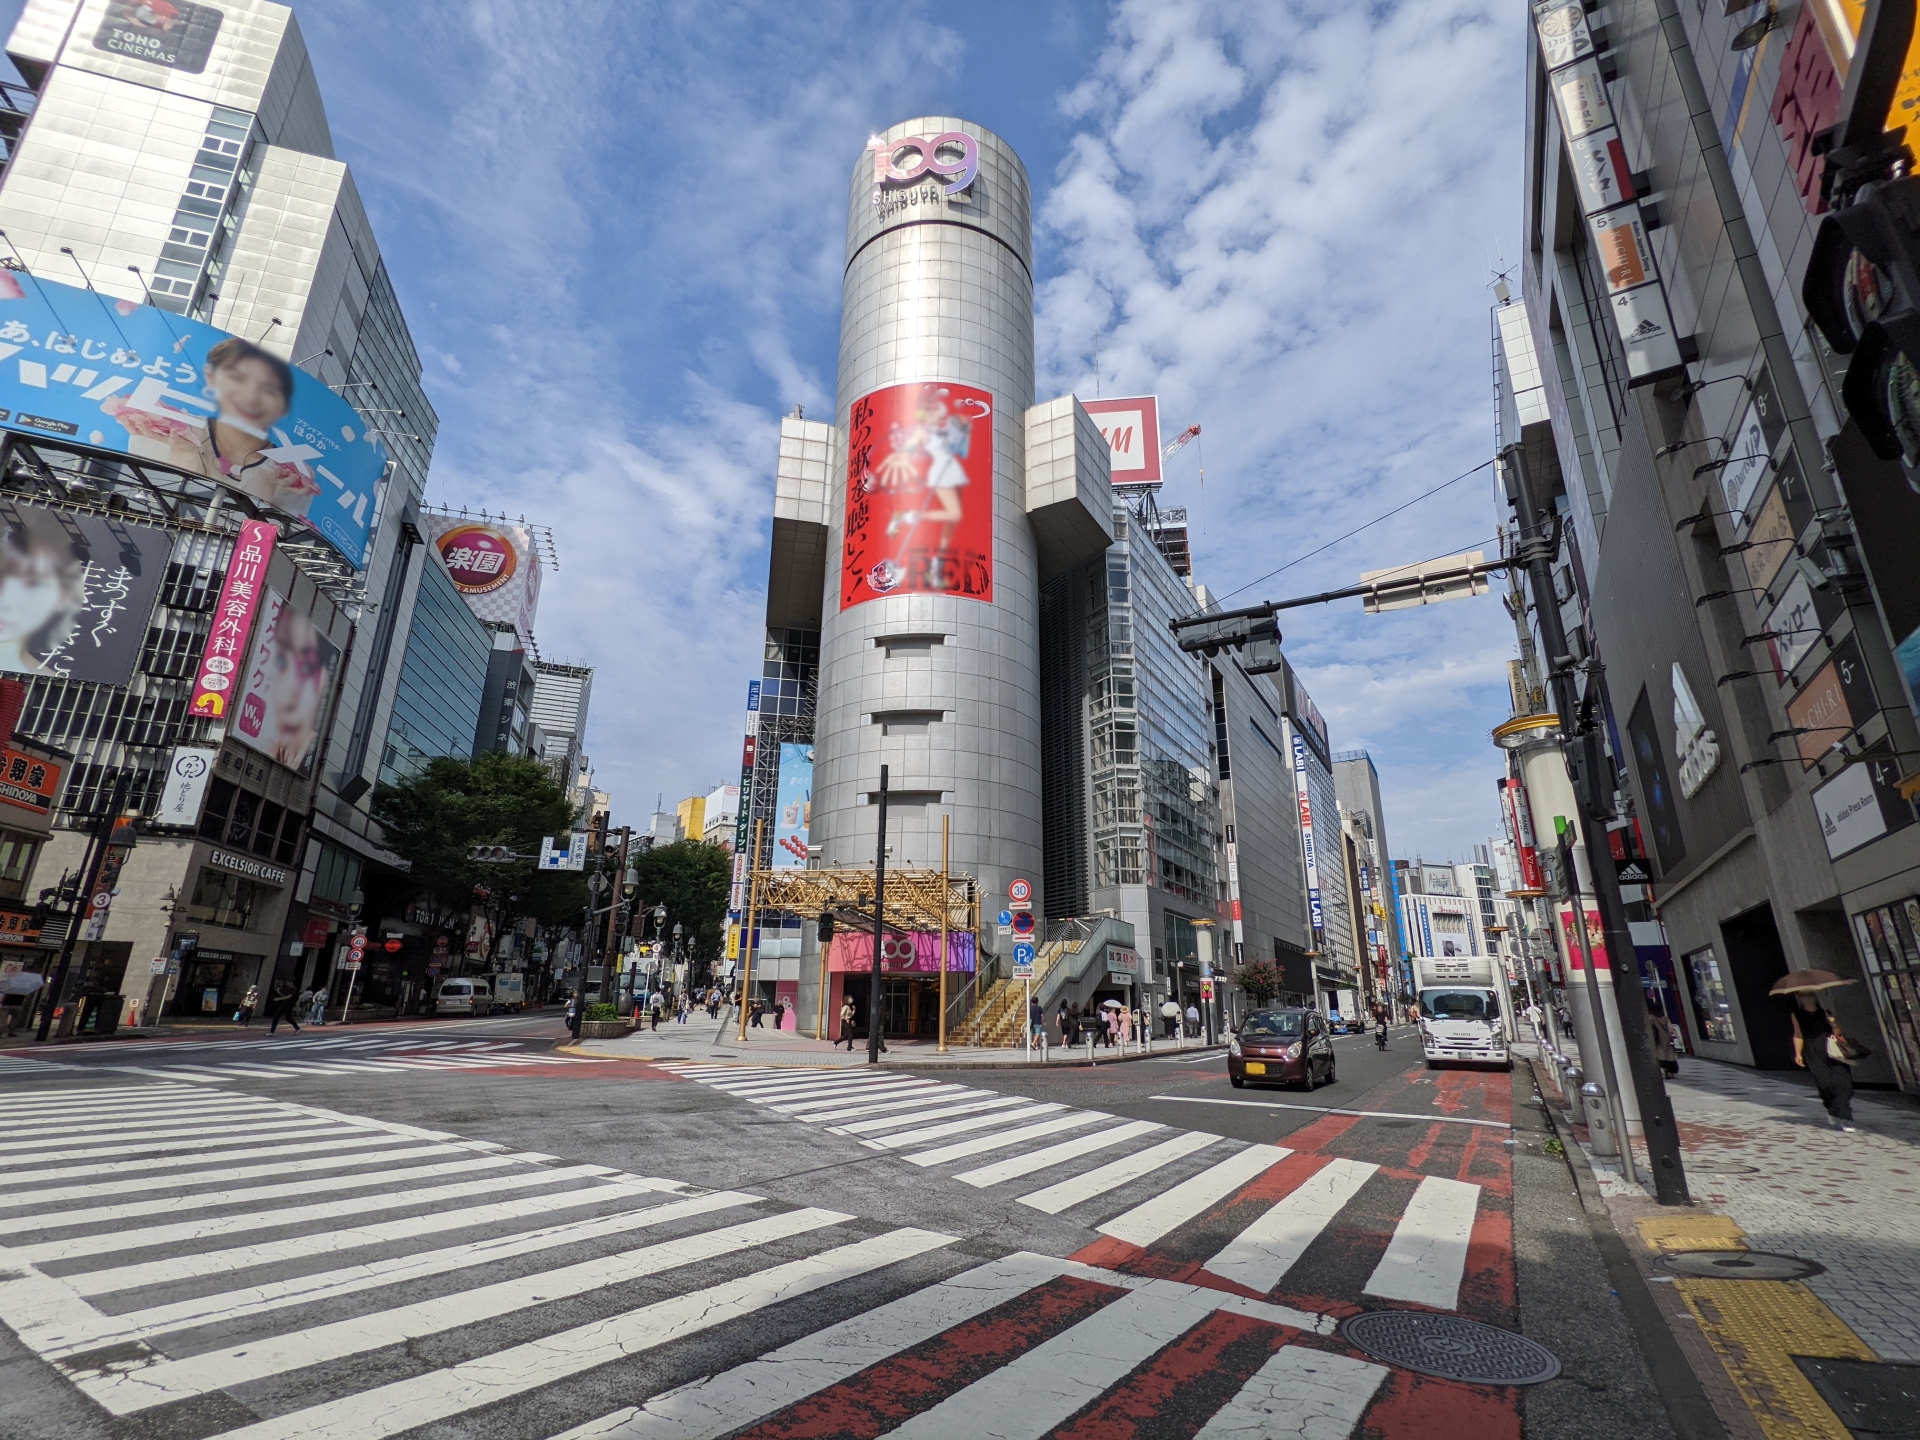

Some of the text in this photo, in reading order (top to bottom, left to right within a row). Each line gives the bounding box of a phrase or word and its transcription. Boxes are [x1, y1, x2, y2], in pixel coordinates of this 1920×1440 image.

[107, 37, 177, 64] CINEMAS
[112, 28, 161, 49] TOHO
[1548, 28, 1586, 48] Darts
[1548, 37, 1590, 65] UP
[867, 131, 979, 196] 109
[1582, 149, 1612, 206] スシロー
[872, 184, 939, 206] SHIBUYA
[1631, 220, 1651, 272] Modern Japanese Dining
[1630, 324, 1662, 338] adidas
[293, 423, 327, 451] ほのか
[446, 547, 506, 574] 楽園
[462, 573, 510, 595] AMUSEMENT
[91, 565, 133, 648] まっすぐ
[212, 544, 263, 657] 品川美容外科
[498, 680, 517, 742] 渋東シネ
[182, 754, 201, 779] つかだ
[1294, 745, 1304, 771] LABI
[1678, 729, 1720, 800] adidas
[172, 781, 191, 812] 地どり屋
[1836, 794, 1875, 823] adidas Press Room
[737, 777, 751, 846] ビリヤード・ダーツ
[1300, 799, 1311, 828] LABI
[1520, 814, 1530, 836] DANCE
[1304, 833, 1315, 868] SHIBUYA
[211, 850, 286, 884] EXCELSIOR CAFFÉ
[1526, 855, 1536, 881] Y!mobile
[1618, 872, 1649, 881] adidas
[96, 894, 106, 906] 3
[1014, 885, 1026, 896] 30
[1310, 900, 1322, 928] LABI
[196, 951, 219, 959] EXCELSIOR
[1017, 948, 1026, 963] P
